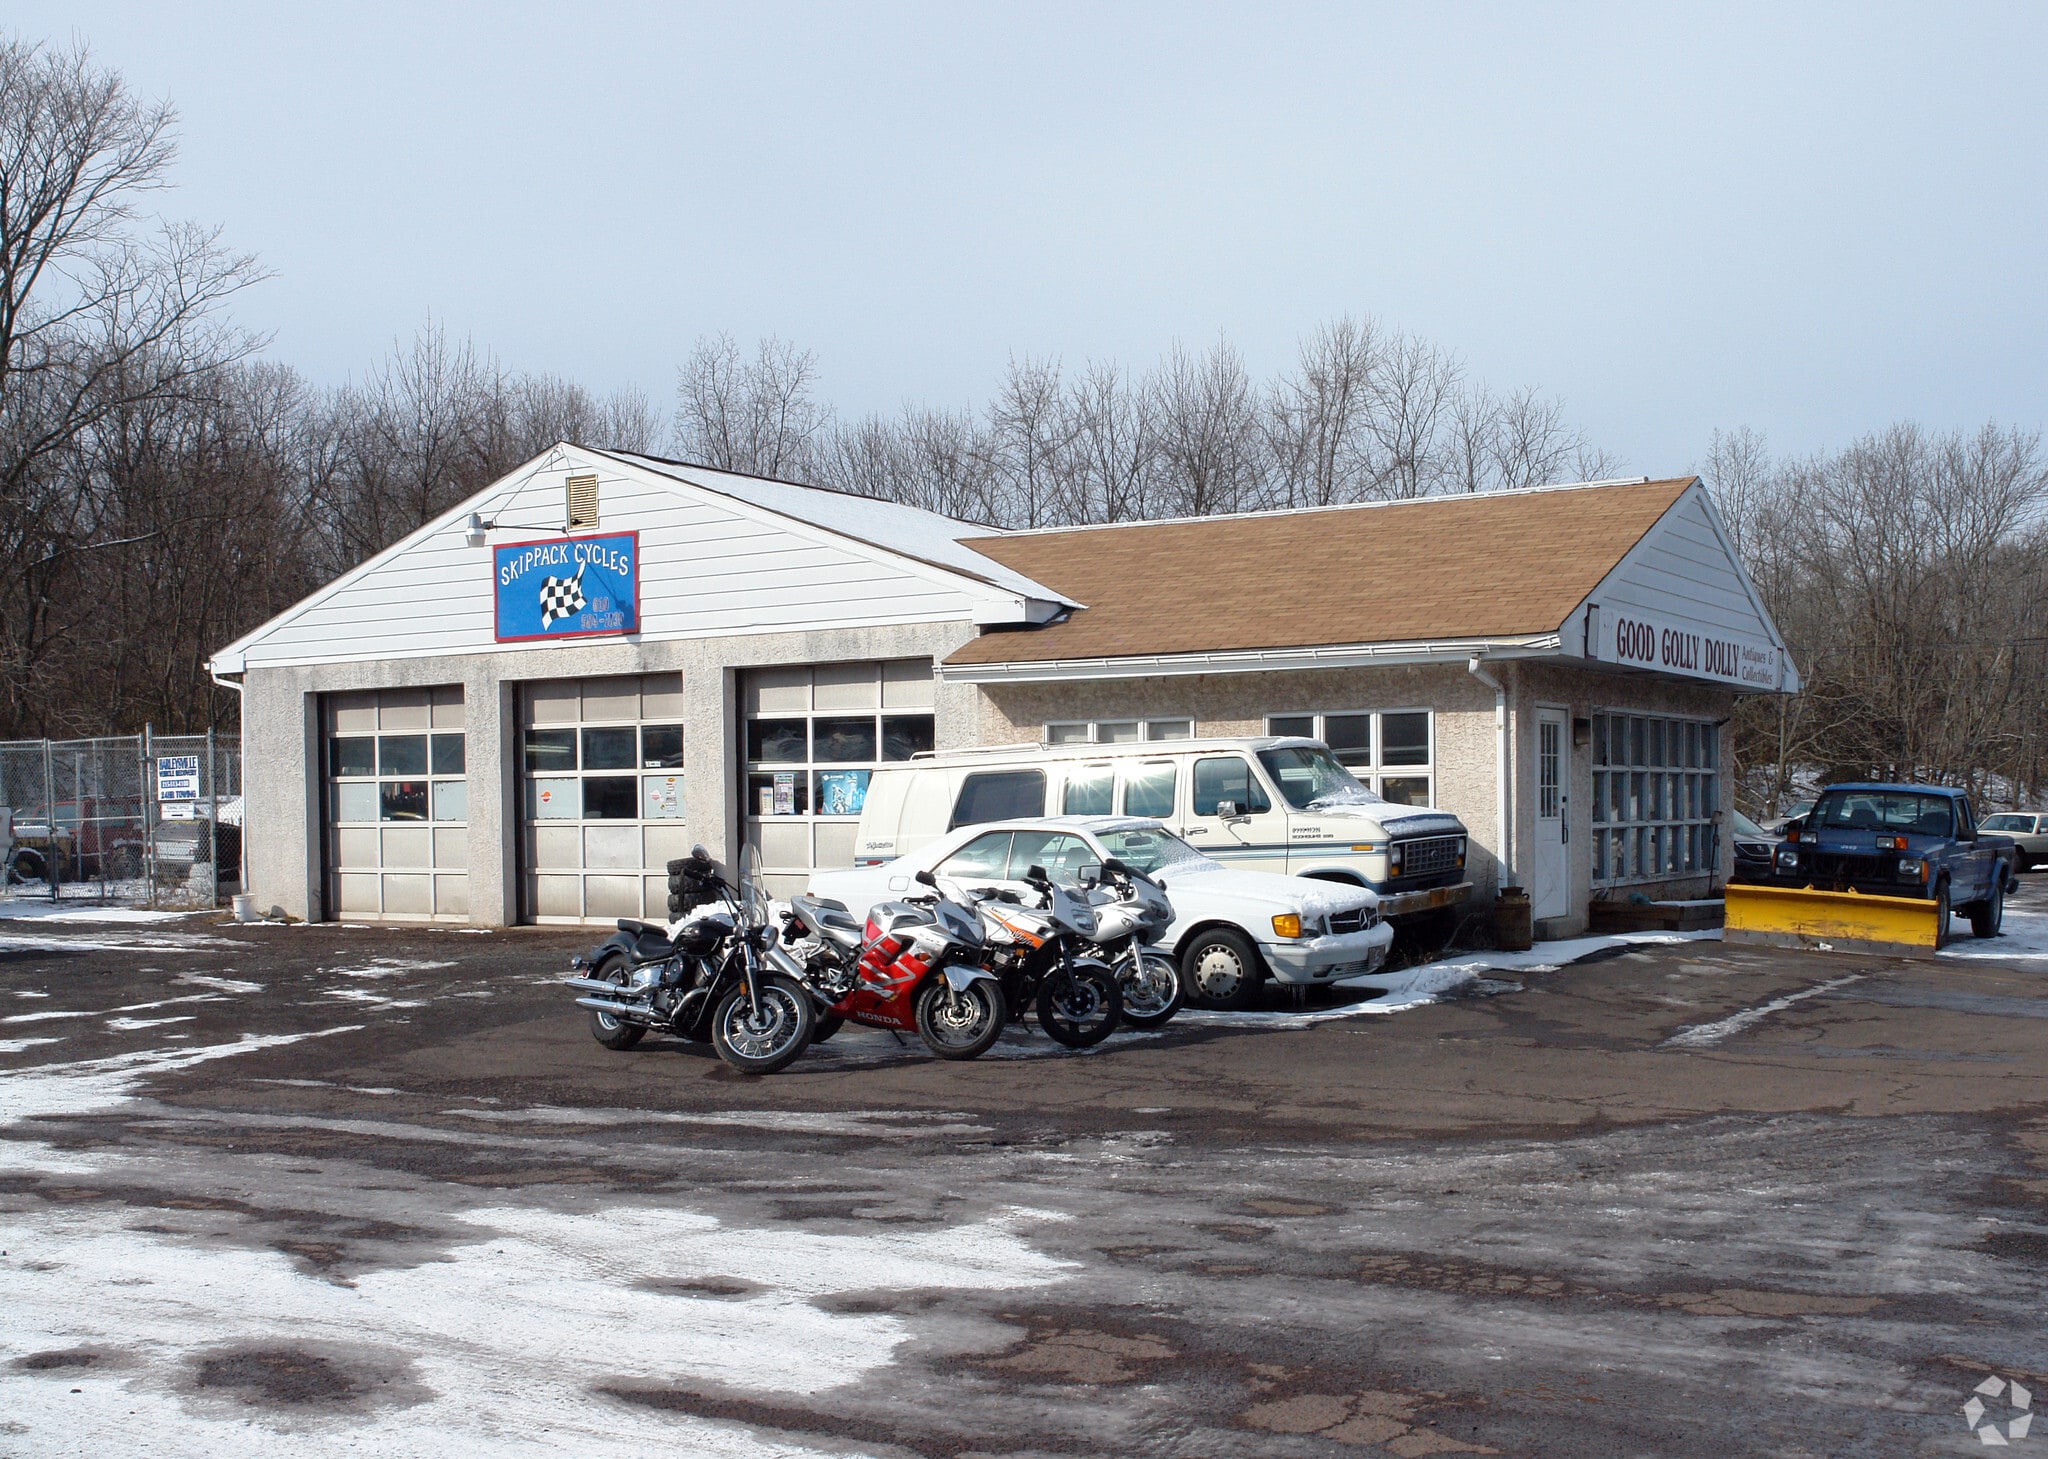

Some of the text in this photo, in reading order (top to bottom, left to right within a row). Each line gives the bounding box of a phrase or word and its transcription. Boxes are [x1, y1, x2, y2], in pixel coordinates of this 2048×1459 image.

[500, 543, 629, 585] SKIPPACK CYCLES
[1616, 617, 1740, 677] GOOD GOLLY DOLLY
[1741, 645, 1766, 665] Antiques
[1741, 665, 1773, 685] Collectibles
[176, 790, 197, 798] TOWING
[856, 1010, 903, 1025] HONDA
